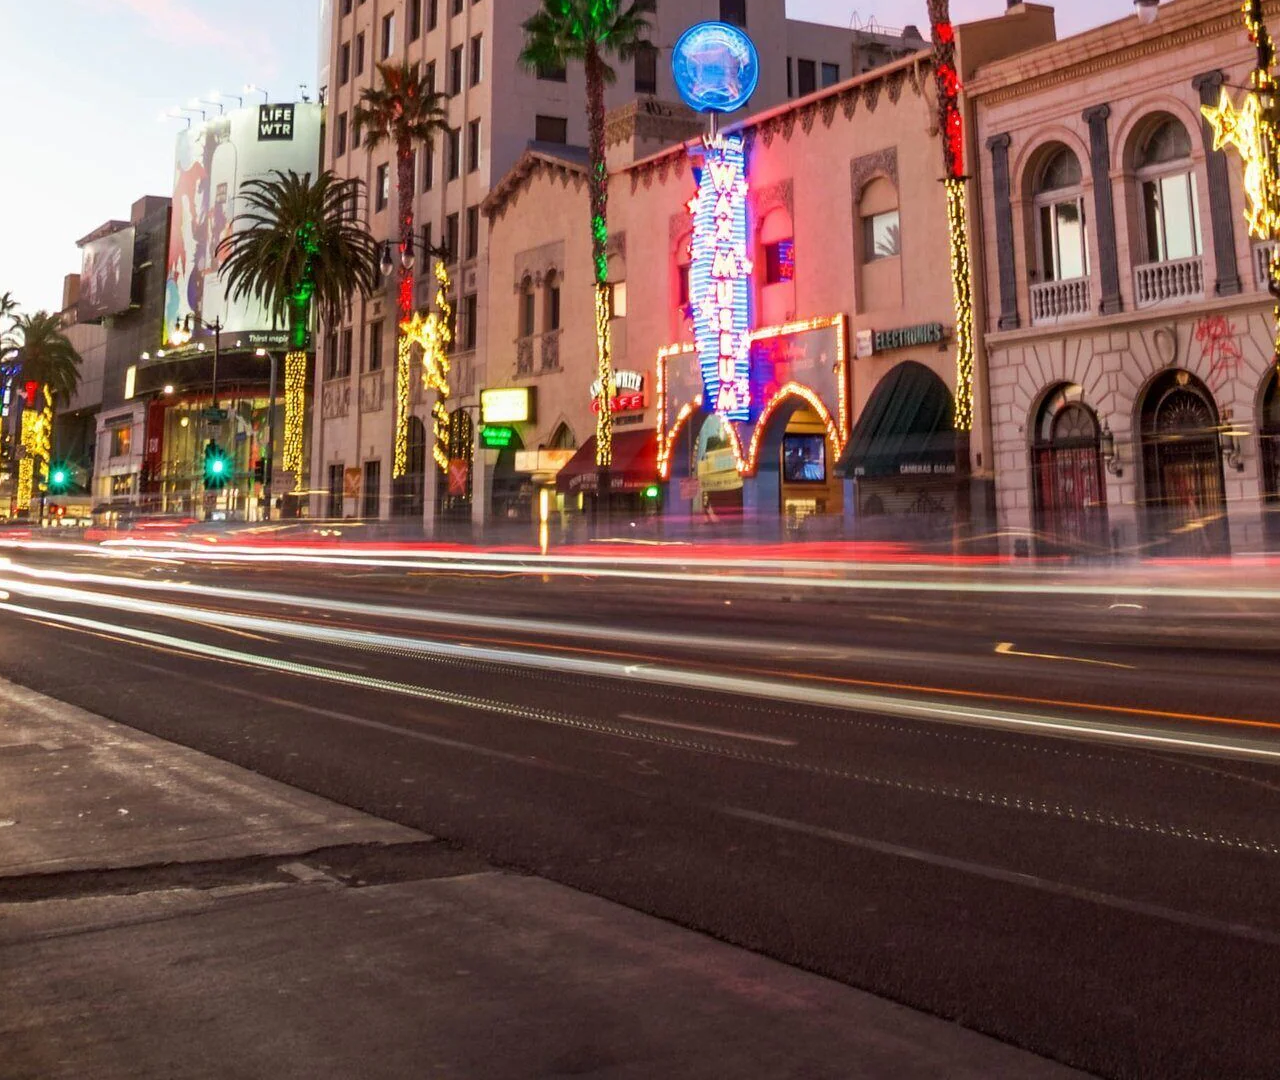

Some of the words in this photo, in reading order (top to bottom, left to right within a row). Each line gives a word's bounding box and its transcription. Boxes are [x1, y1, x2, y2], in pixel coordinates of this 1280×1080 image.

[261, 109, 292, 122] LIFE
[260, 123, 291, 136] WTR
[708, 161, 738, 241] WAX
[249, 334, 268, 343] Thirst
[875, 323, 941, 351] ELECTRONICS
[900, 464, 932, 474] CAMERAS
[933, 464, 956, 474] GALOR
